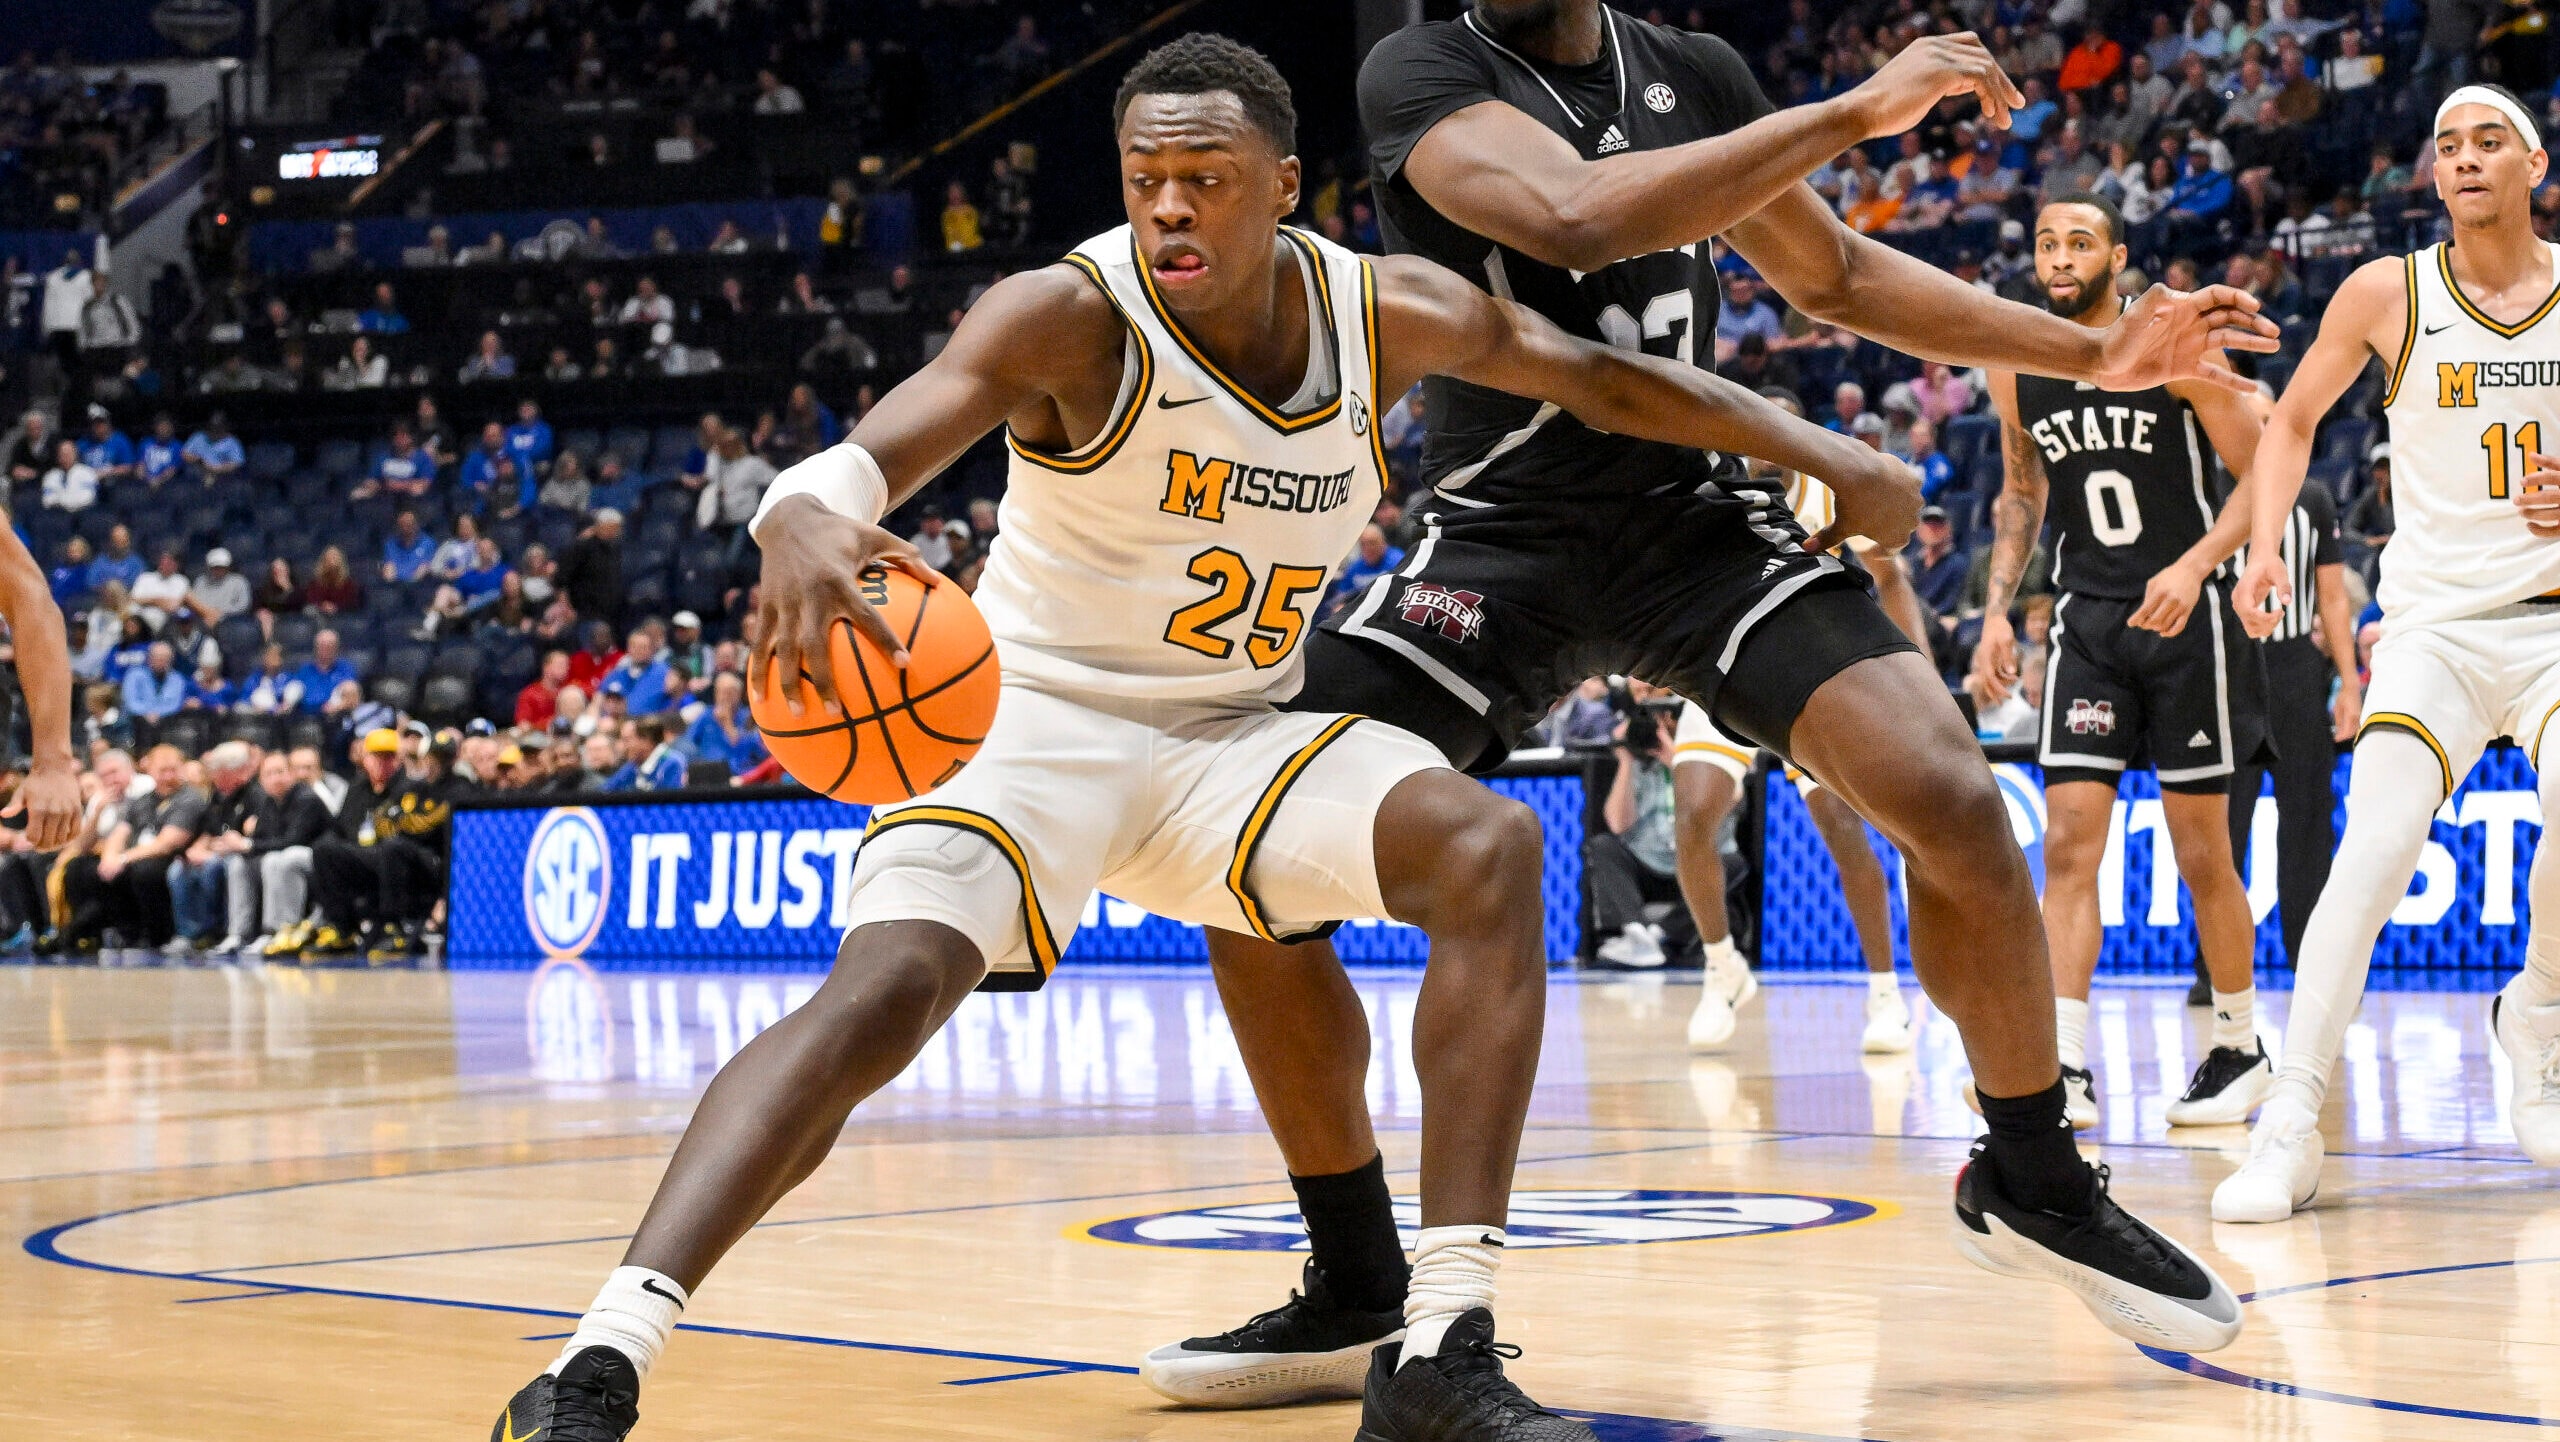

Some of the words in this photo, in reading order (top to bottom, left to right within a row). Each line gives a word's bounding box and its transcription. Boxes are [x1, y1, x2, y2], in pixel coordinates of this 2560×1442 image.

[1646, 85, 1674, 112] SEC
[1597, 140, 1629, 154] adidas
[2032, 405, 2158, 464] STATE
[2481, 421, 2543, 499] 11
[2084, 469, 2143, 547] 0
[1163, 546, 1327, 670] 25
[1415, 591, 1469, 623] STATE
[627, 832, 692, 929] IT
[694, 828, 864, 929] JUST
